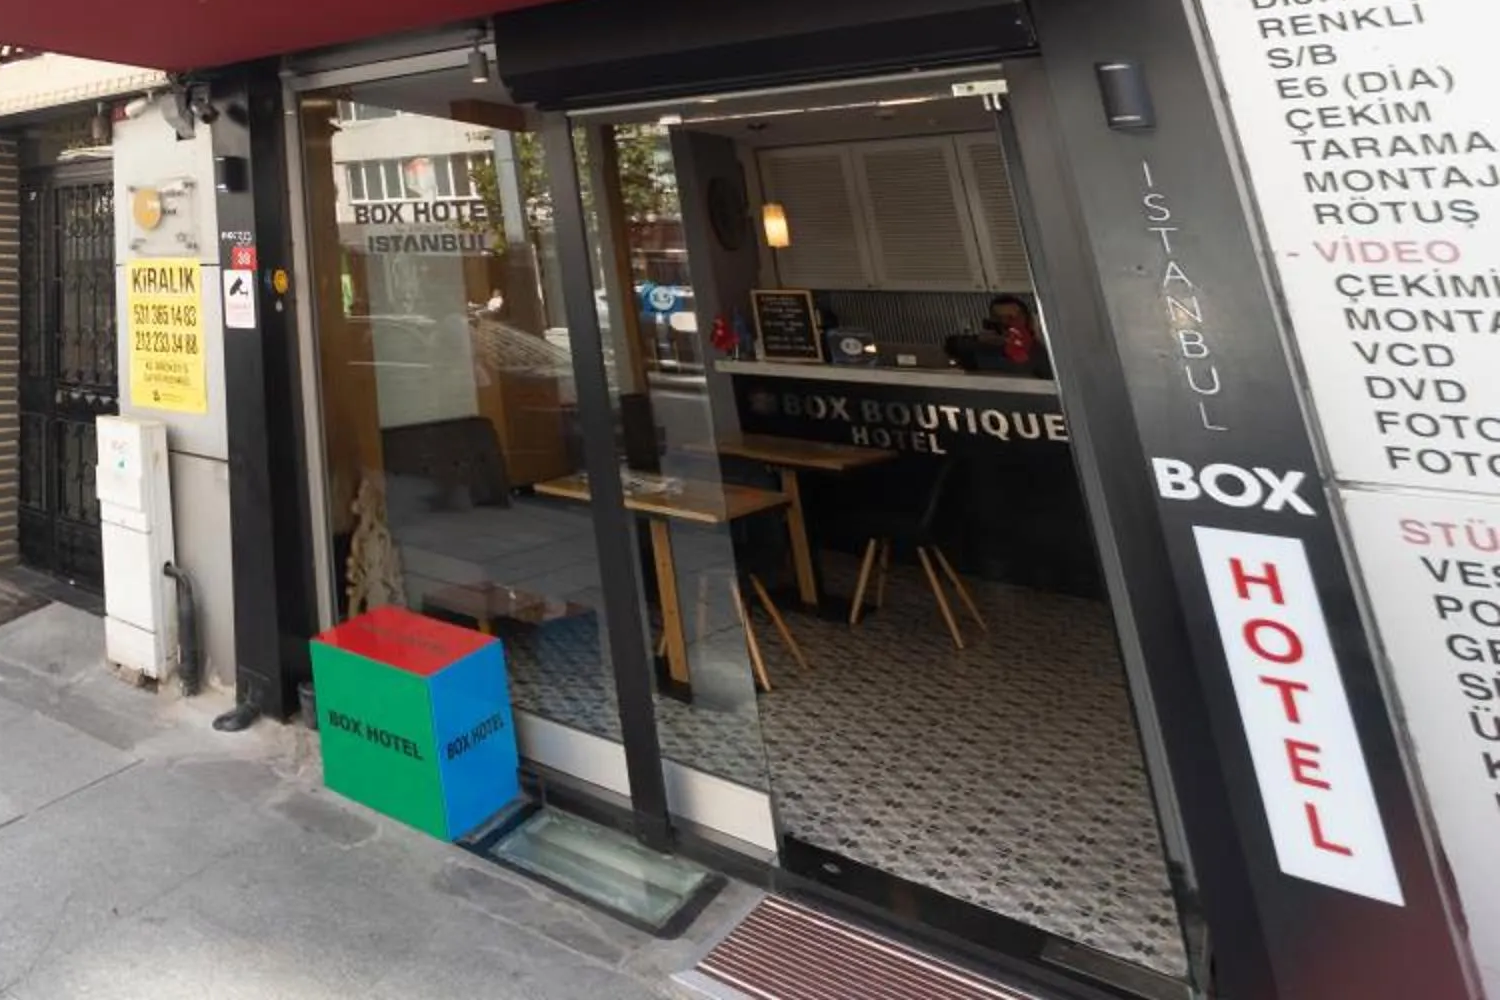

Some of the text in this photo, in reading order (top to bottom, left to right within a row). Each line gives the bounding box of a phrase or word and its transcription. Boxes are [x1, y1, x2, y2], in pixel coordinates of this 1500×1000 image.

[1267, 44, 1337, 69] S/B
[1276, 64, 1454, 99] E6 (DİA)
[1285, 97, 1431, 135] ÇEKİM
[1291, 131, 1496, 161] TARAMA
[1304, 164, 1500, 193] MONTAJ
[355, 203, 404, 224] BOX
[1313, 196, 1480, 229] RÖTUŞ
[1313, 235, 1460, 264] VİDEO
[1143, 161, 1228, 431] ISTANBUL
[1353, 342, 1455, 367] VCD
[1365, 376, 1466, 402] DVD
[783, 394, 1069, 441] BOX BOUTIQUE
[852, 426, 947, 455] HOTEL
[1151, 457, 1316, 517] BOX
[1229, 557, 1353, 858] HOTEL
[328, 709, 424, 761] BOX HOTEL
[447, 712, 504, 760] BOX HOTEL
